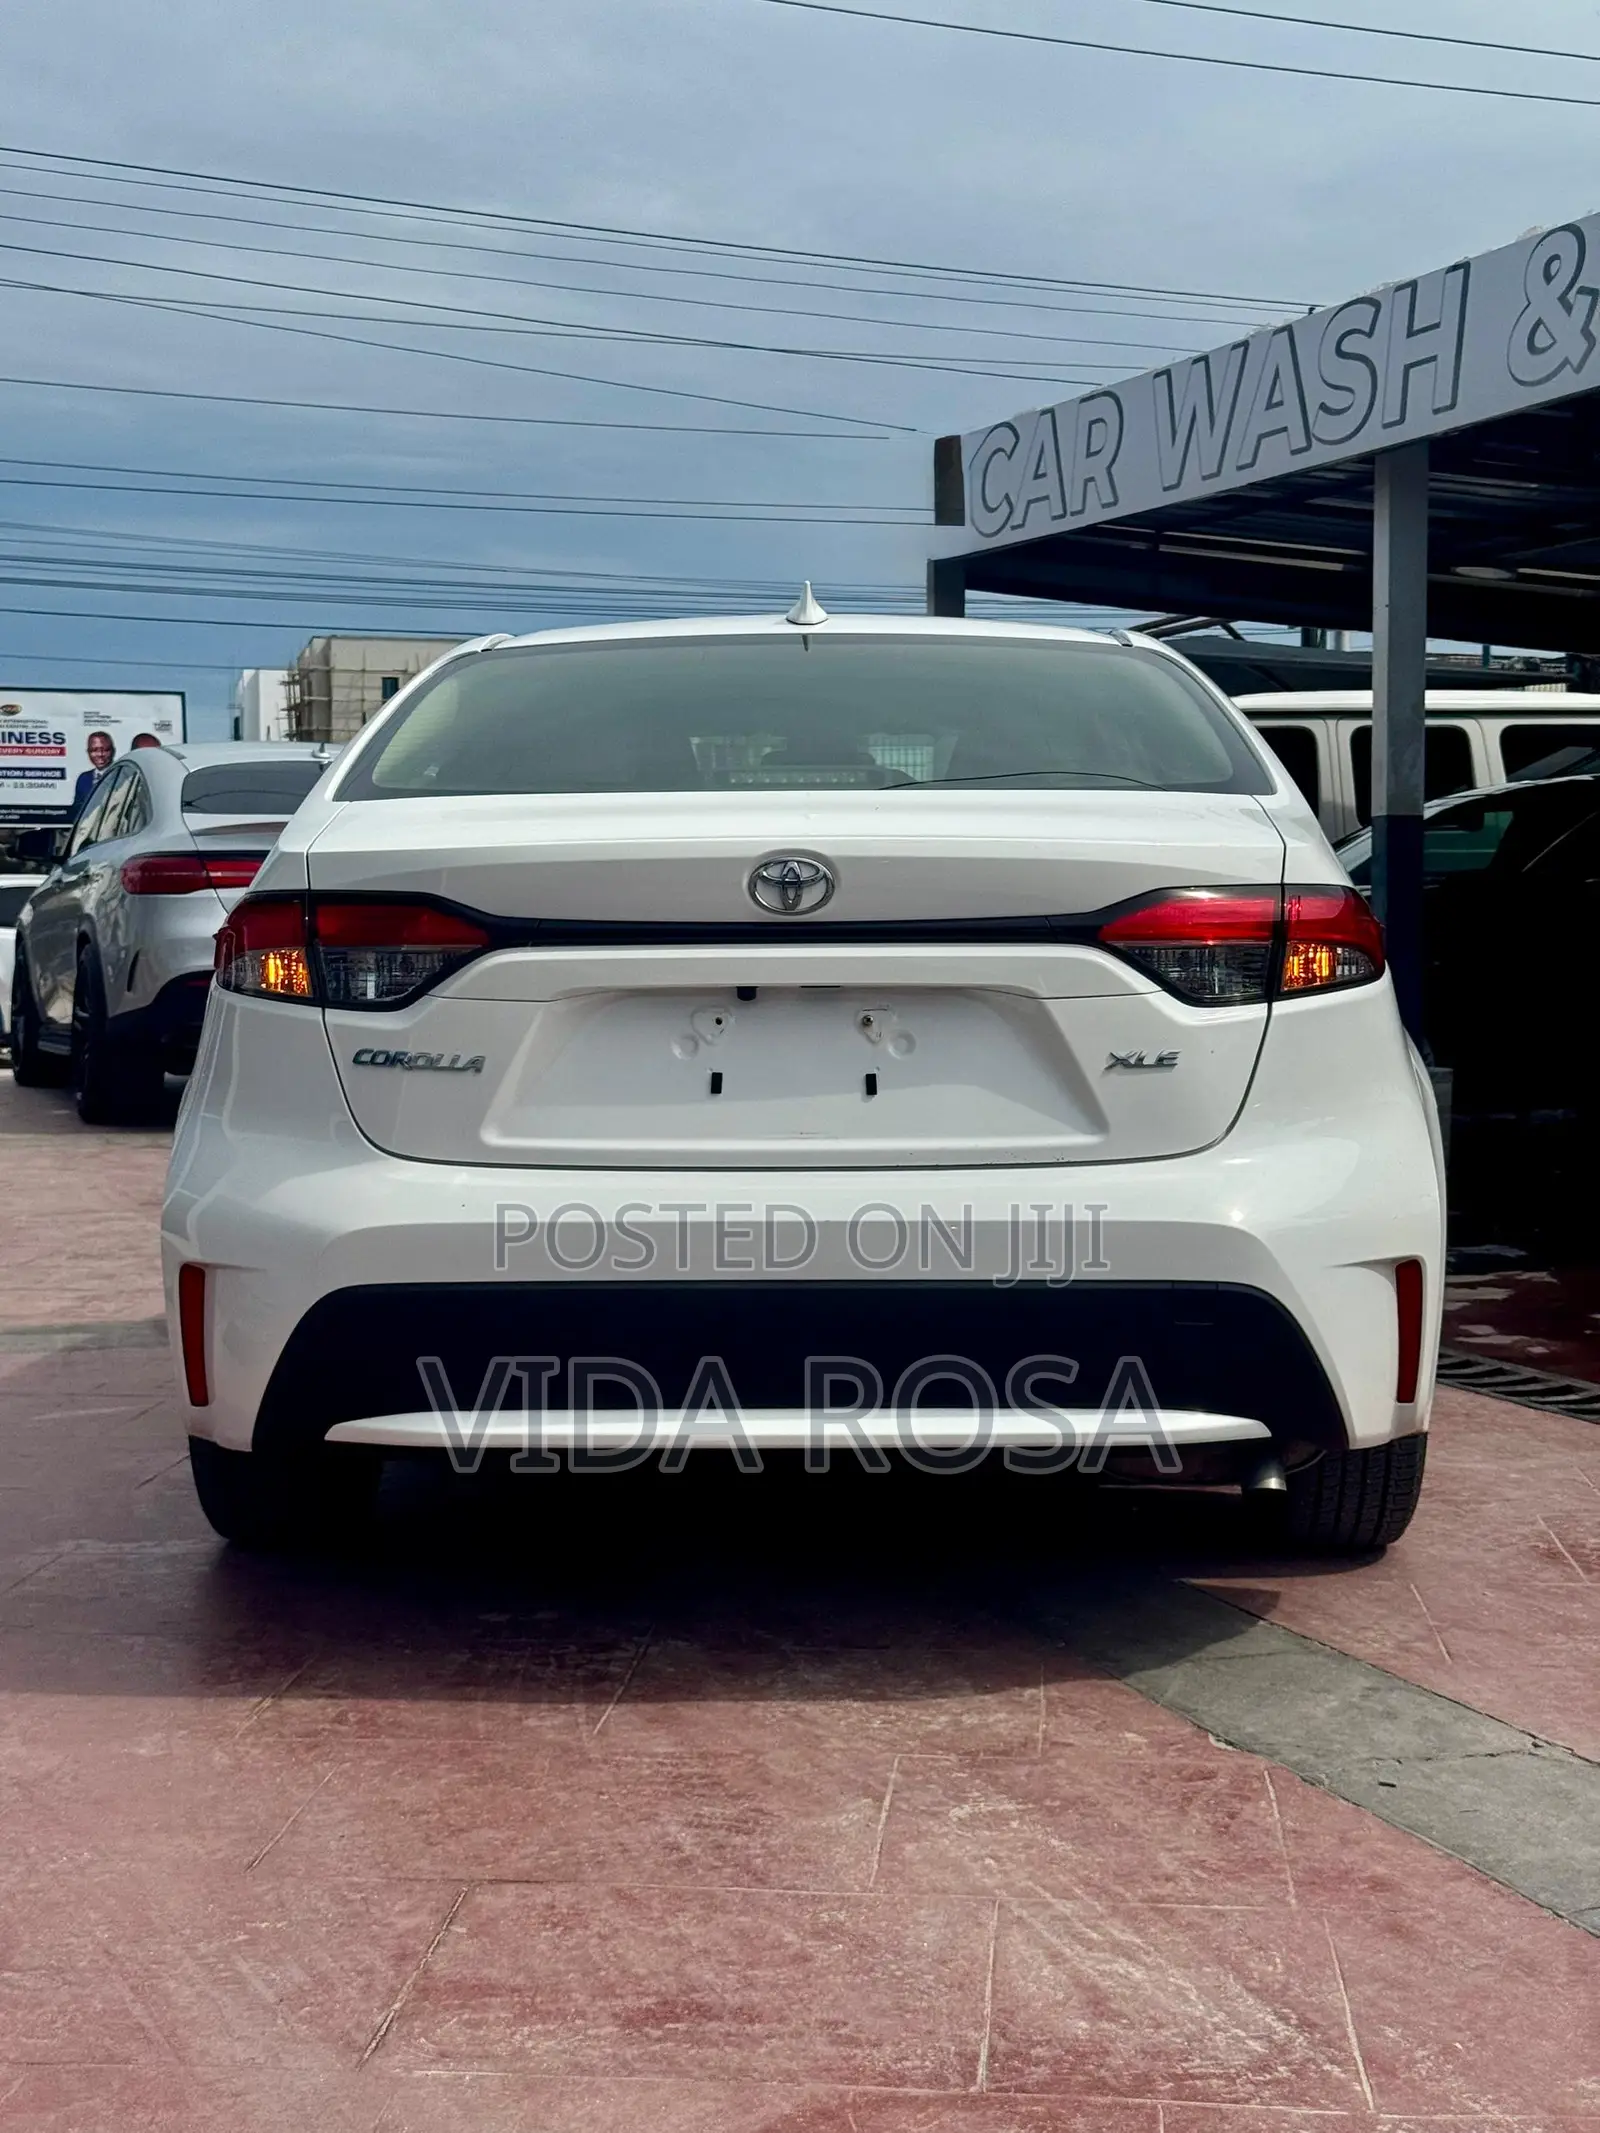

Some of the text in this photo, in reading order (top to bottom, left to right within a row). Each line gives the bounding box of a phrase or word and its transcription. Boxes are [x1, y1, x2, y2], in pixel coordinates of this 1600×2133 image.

[969, 222, 1600, 538] CAR WASH &
[0, 731, 66, 745] INESS
[24, 747, 61, 755] SUNDAY
[0, 770, 62, 778] TION SERVICE
[352, 1048, 486, 1074] COROLLA
[1102, 1048, 1182, 1074] XLE
